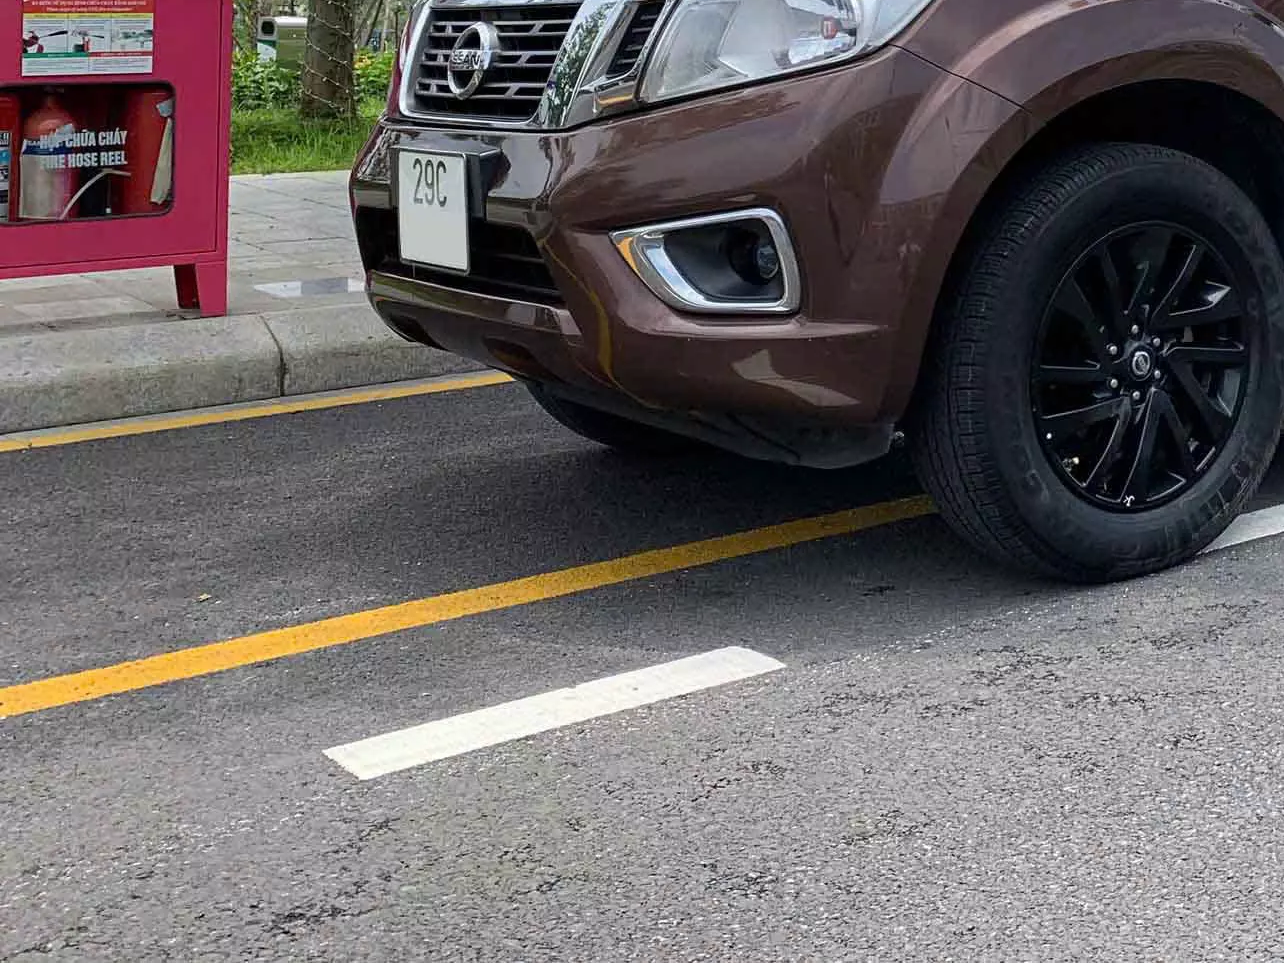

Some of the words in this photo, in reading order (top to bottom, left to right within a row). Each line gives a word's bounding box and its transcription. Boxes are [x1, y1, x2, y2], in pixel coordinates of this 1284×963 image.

[68, 152, 98, 167] HOSE
[100, 150, 128, 166] REEL
[413, 158, 447, 207] 29C
